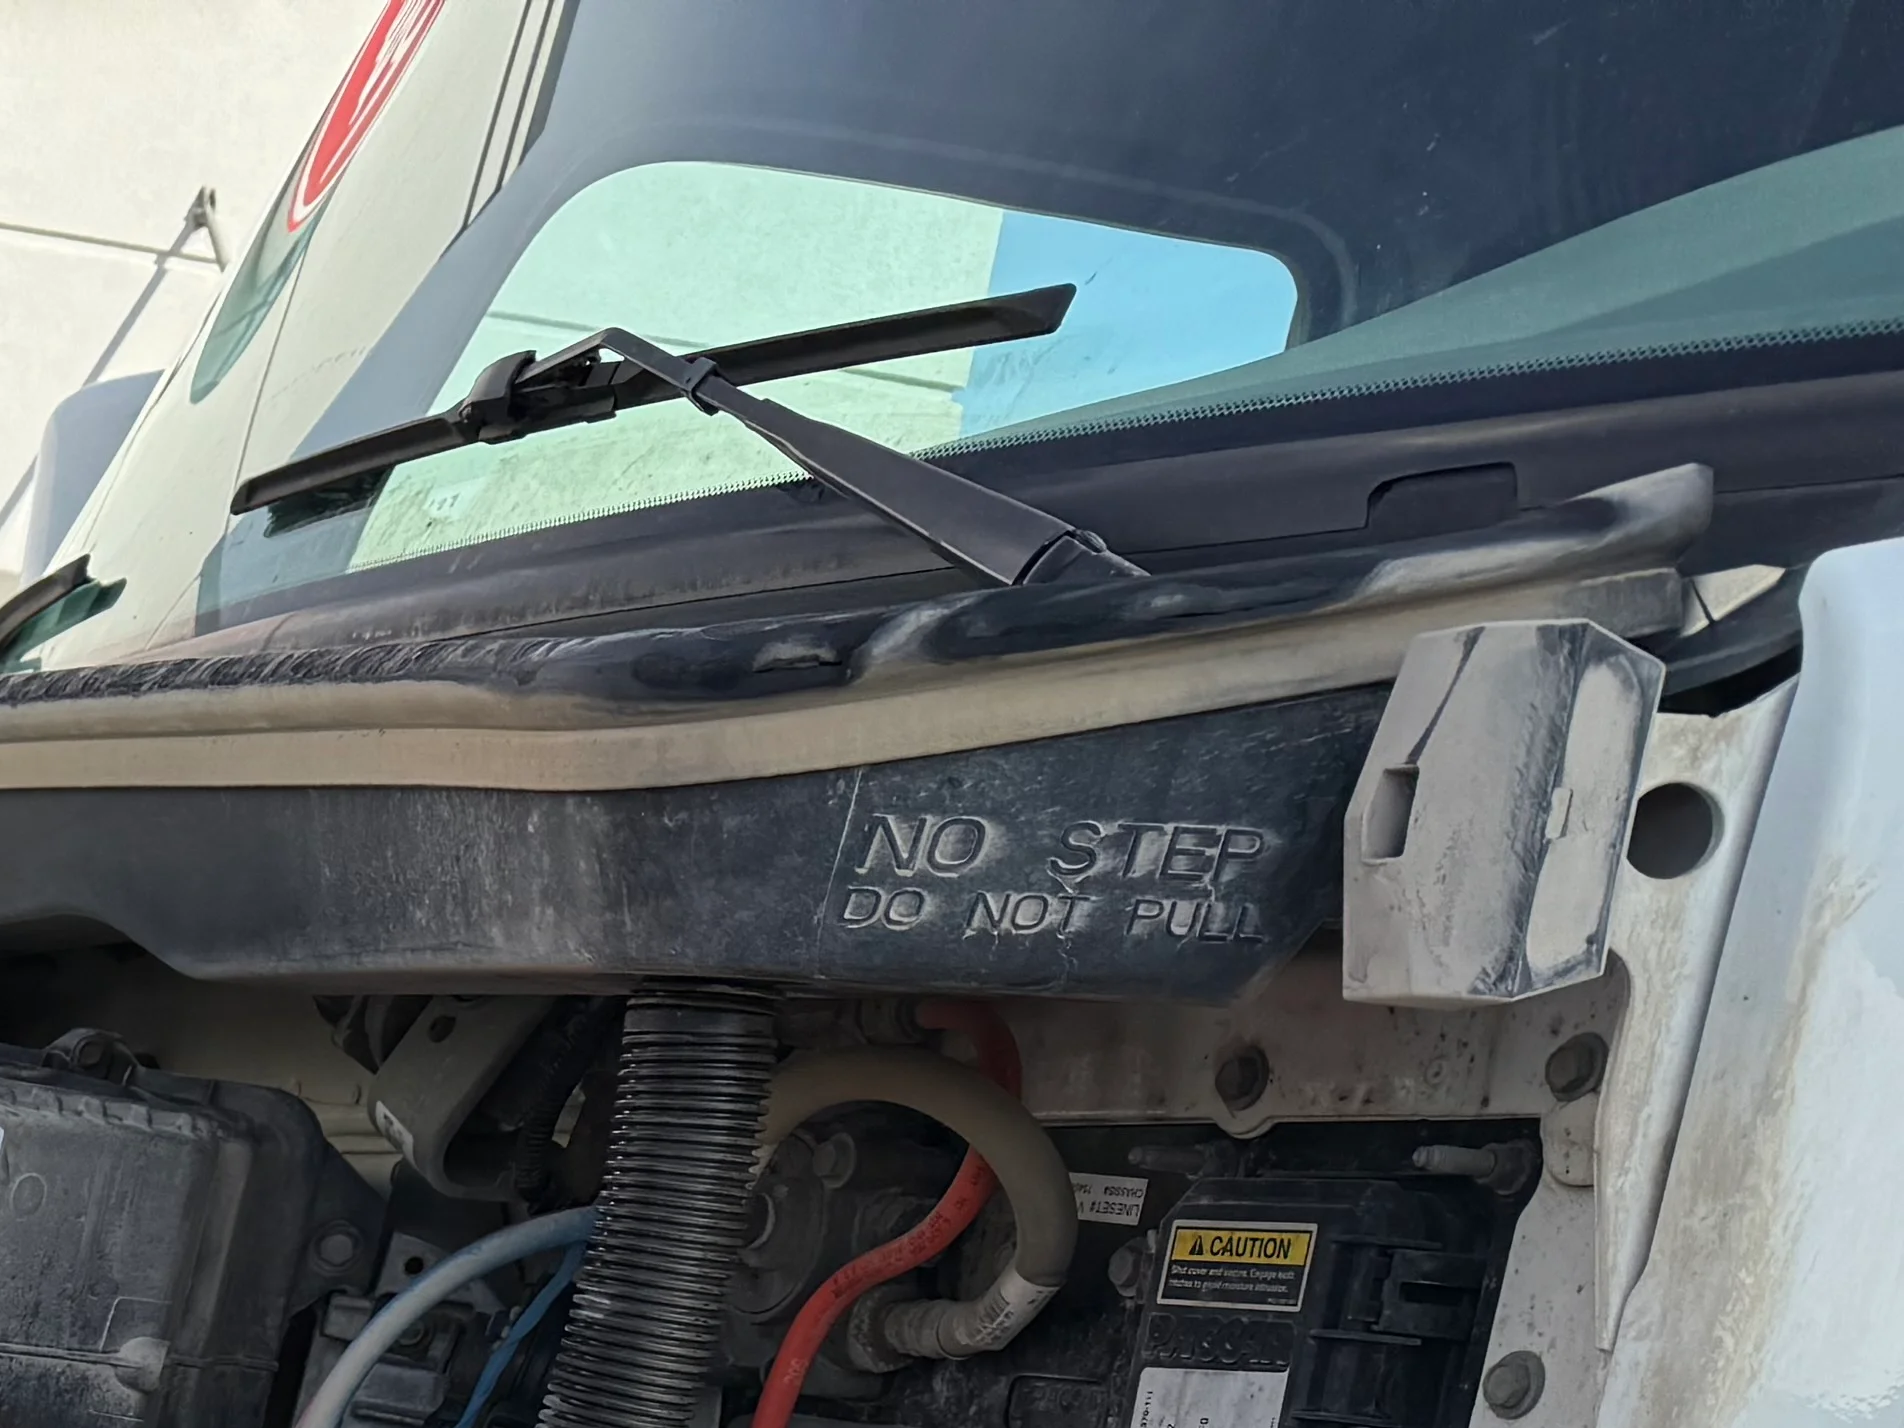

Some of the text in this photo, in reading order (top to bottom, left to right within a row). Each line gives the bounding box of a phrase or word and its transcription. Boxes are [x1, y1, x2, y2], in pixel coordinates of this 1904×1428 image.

[856, 812, 1269, 887] NO STEP
[841, 886, 1267, 943] DO NOT PULL
[1209, 1234, 1292, 1260] CAUTION
